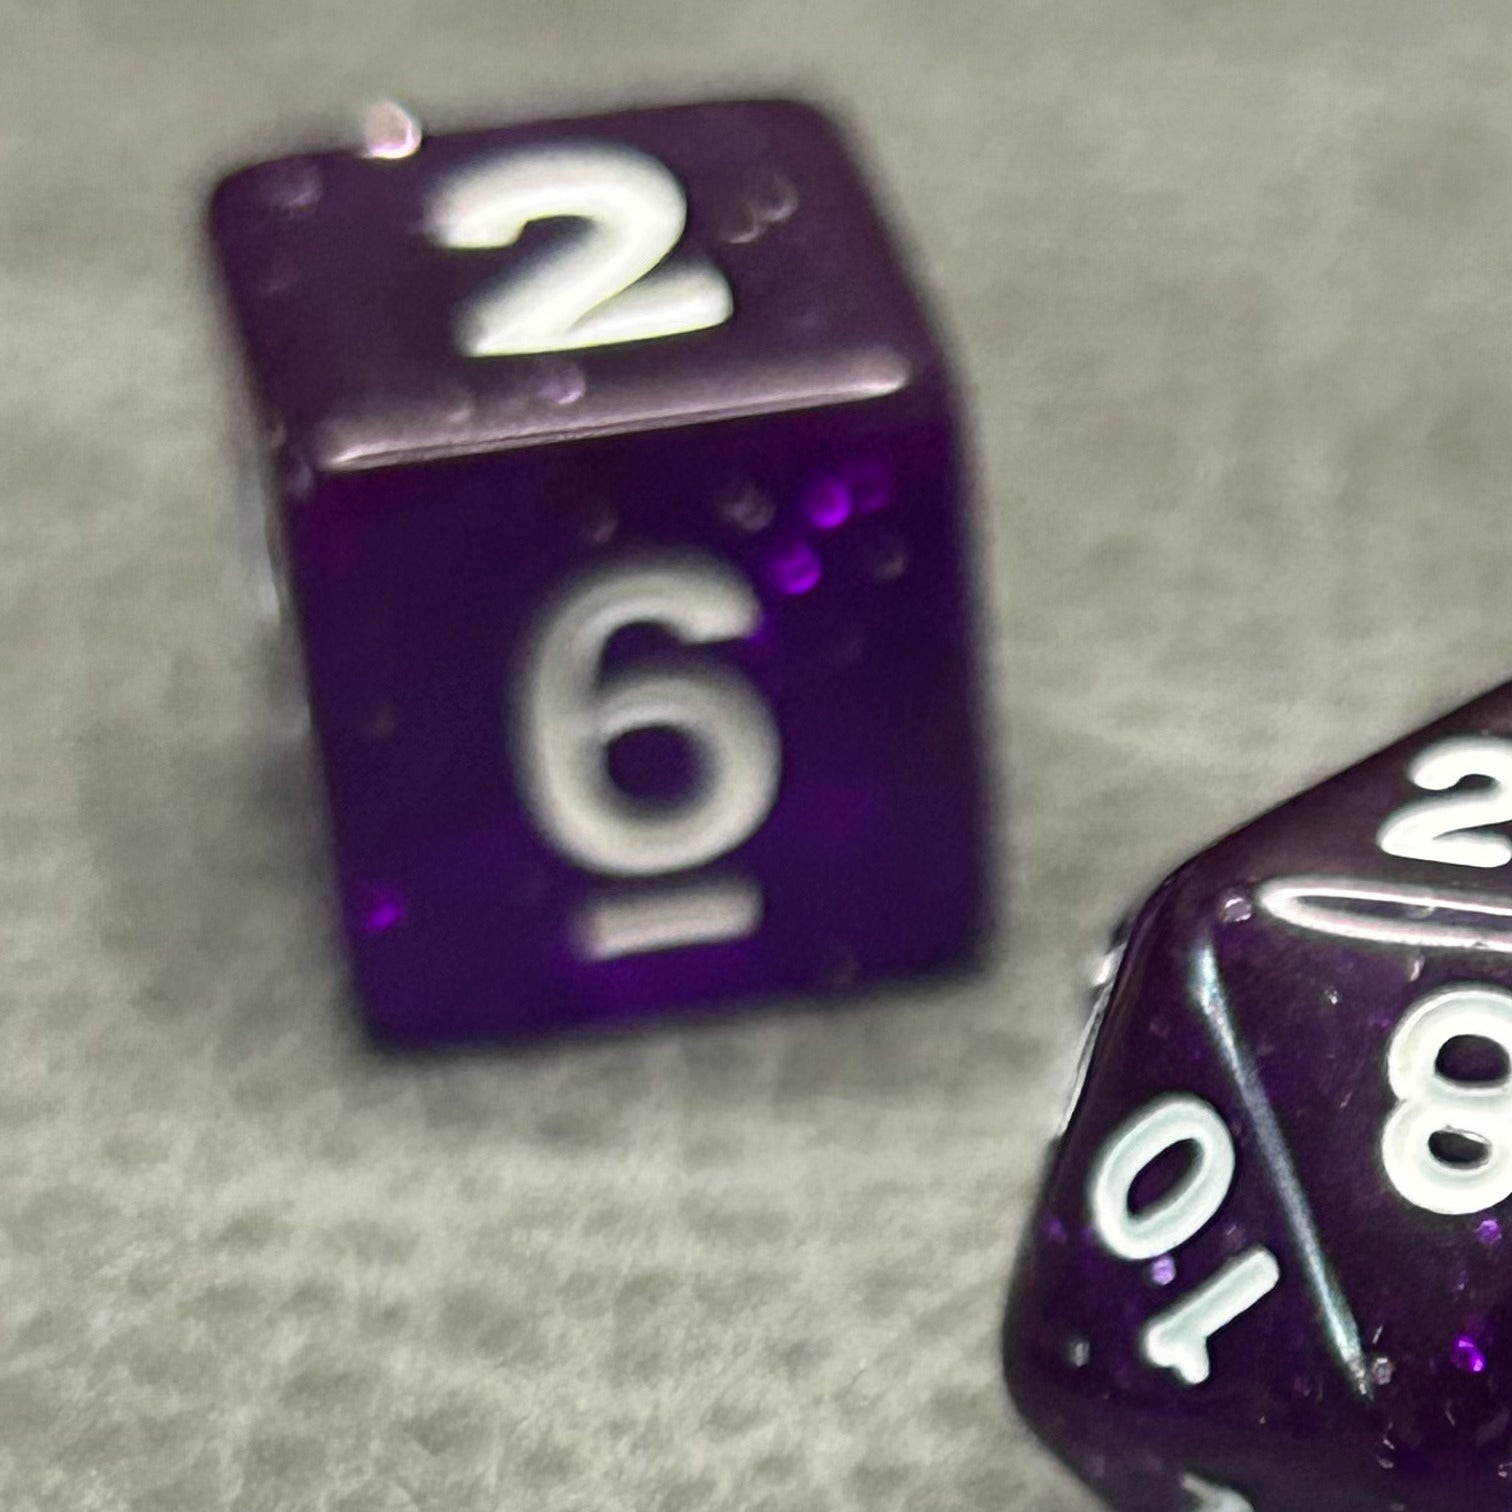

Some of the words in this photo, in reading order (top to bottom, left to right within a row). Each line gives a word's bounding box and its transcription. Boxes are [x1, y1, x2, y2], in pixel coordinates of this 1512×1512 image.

[425, 142, 734, 358] 2
[517, 556, 782, 880] 6
[1088, 1096, 1282, 1386] 10
